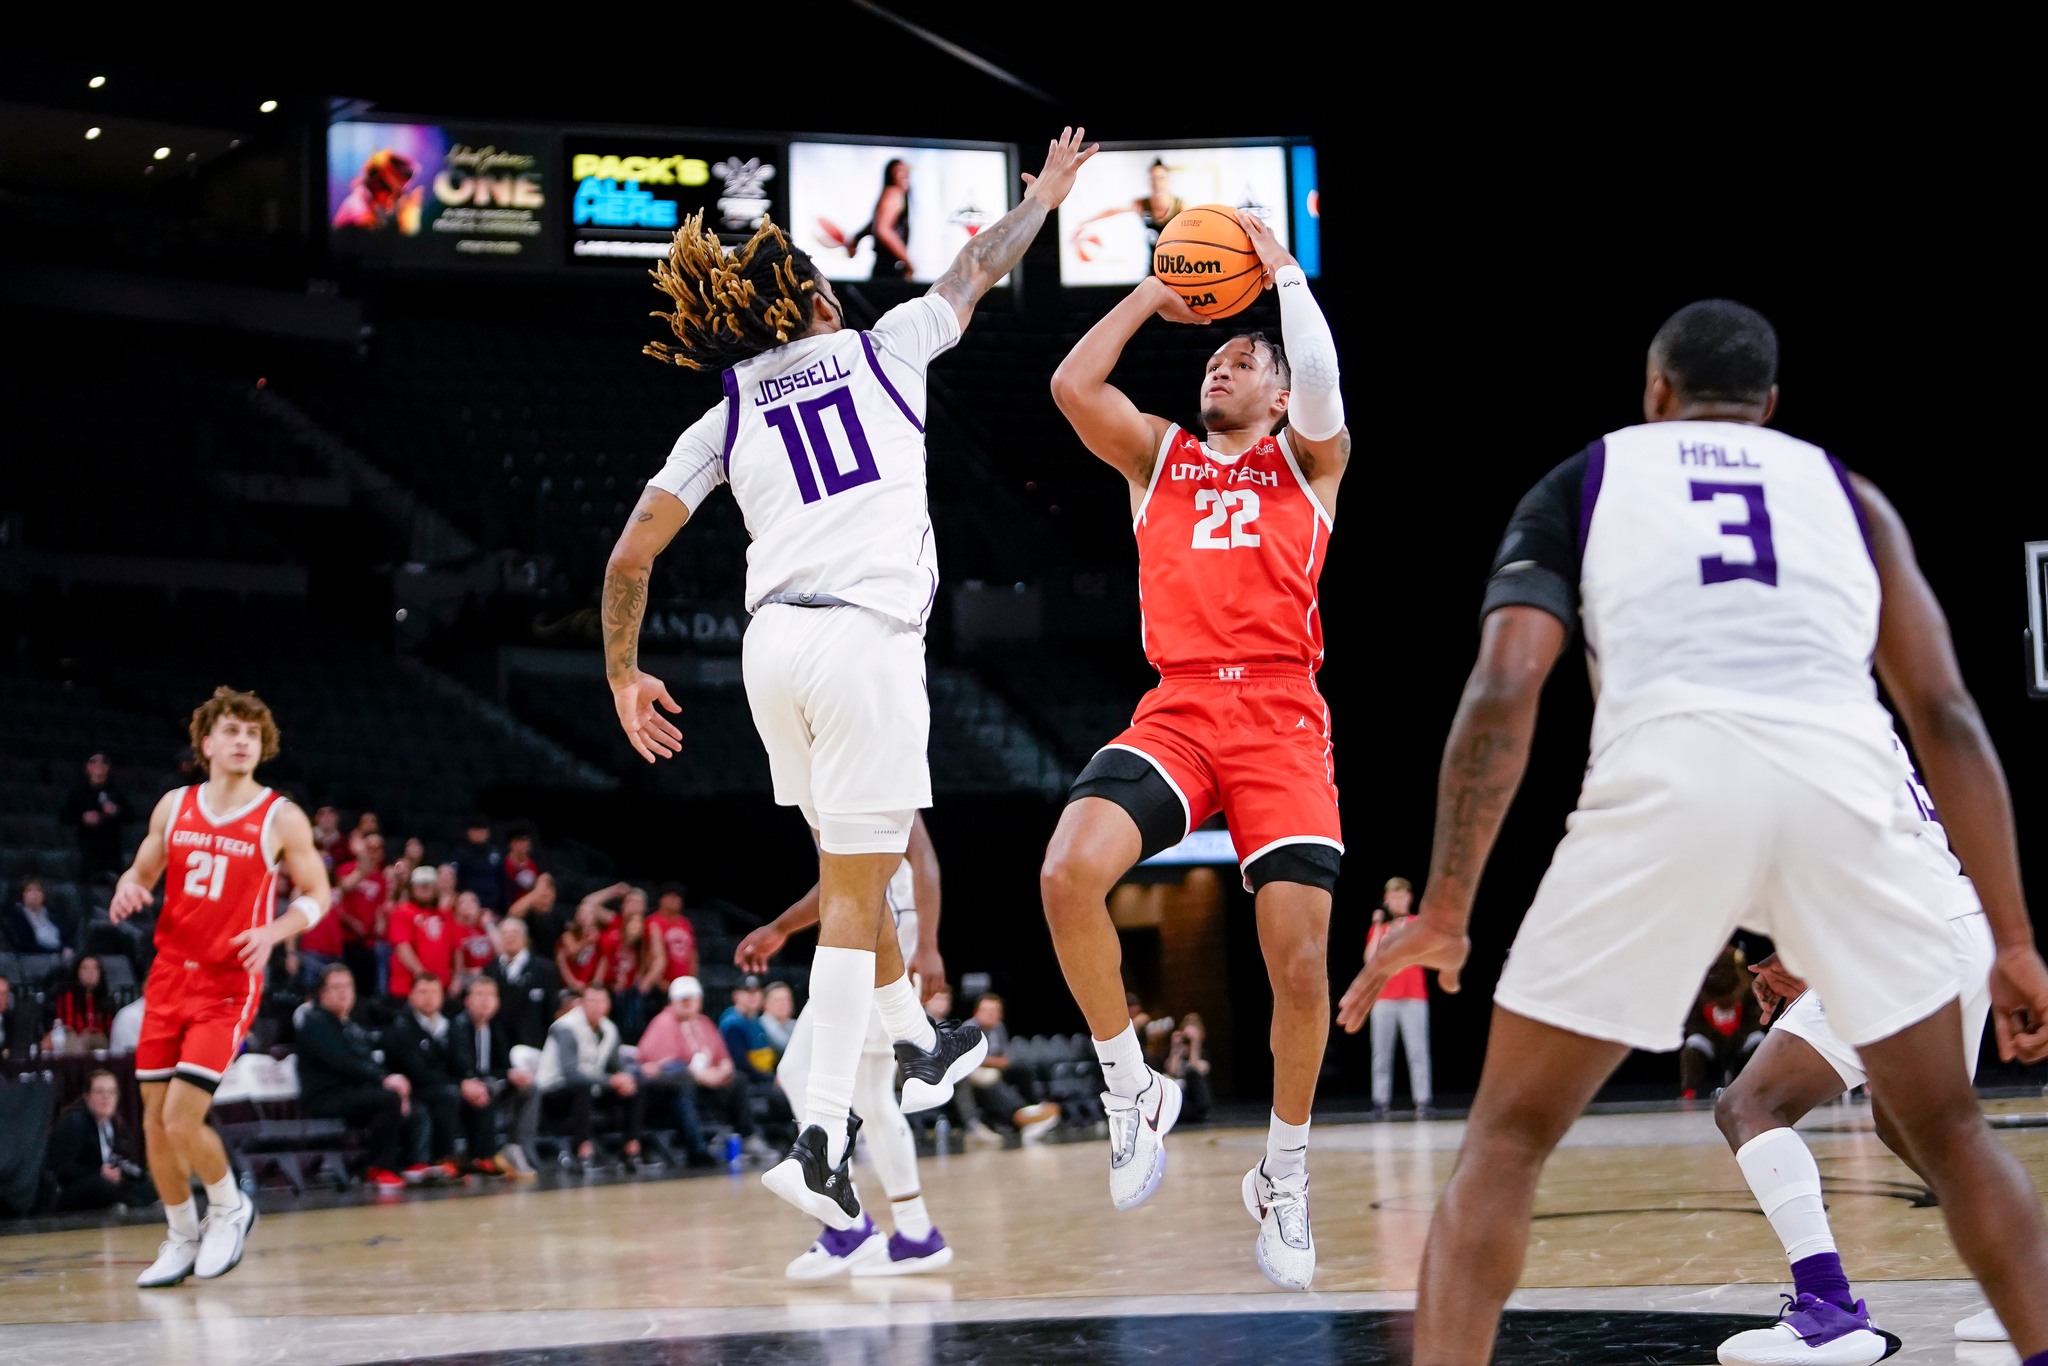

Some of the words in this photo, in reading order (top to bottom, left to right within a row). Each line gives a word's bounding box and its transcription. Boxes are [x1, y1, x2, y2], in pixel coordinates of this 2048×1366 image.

[573, 154, 709, 185] PACK'S
[434, 170, 545, 208] ONE
[575, 177, 654, 201] ALL
[573, 199, 678, 227] HERE
[1157, 254, 1221, 274] Wilson
[1182, 292, 1218, 308] CAA
[754, 355, 851, 406] JOSSELL
[763, 385, 881, 504] 10
[1679, 441, 1760, 468] HALL
[1171, 463, 1218, 481] UTAH
[1227, 466, 1278, 487] TECH
[1191, 488, 1260, 549] 22
[1689, 480, 1777, 586] 3
[172, 830, 212, 849] UTAH
[215, 835, 255, 858] TECH
[184, 850, 228, 900] 21
